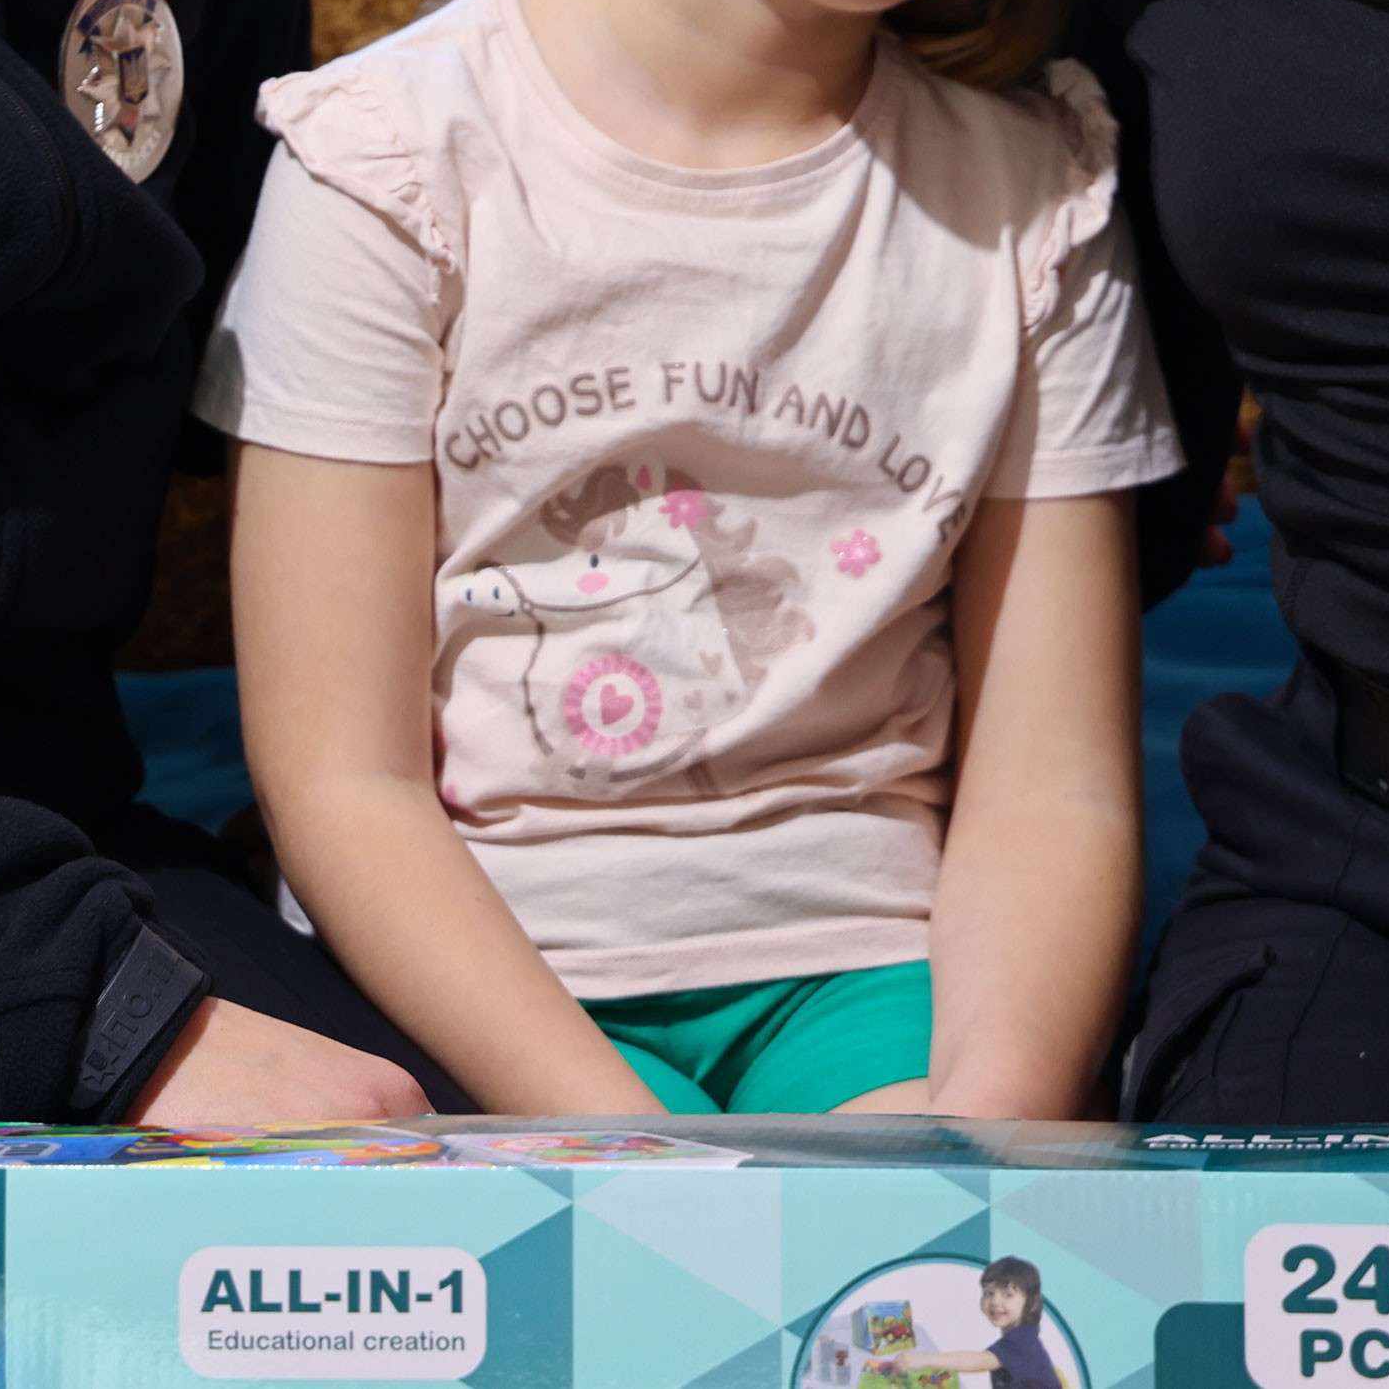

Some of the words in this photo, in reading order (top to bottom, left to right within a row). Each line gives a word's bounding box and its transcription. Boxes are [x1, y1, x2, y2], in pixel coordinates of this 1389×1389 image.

[443, 365, 636, 473] CHOOSE
[661, 361, 761, 414] FUN
[773, 384, 872, 452] AND
[879, 432, 968, 543] LOVE
[200, 1268, 464, 1314] ALL-IN-1
[208, 1329, 354, 1351] Educational
[363, 1330, 466, 1351] creation
